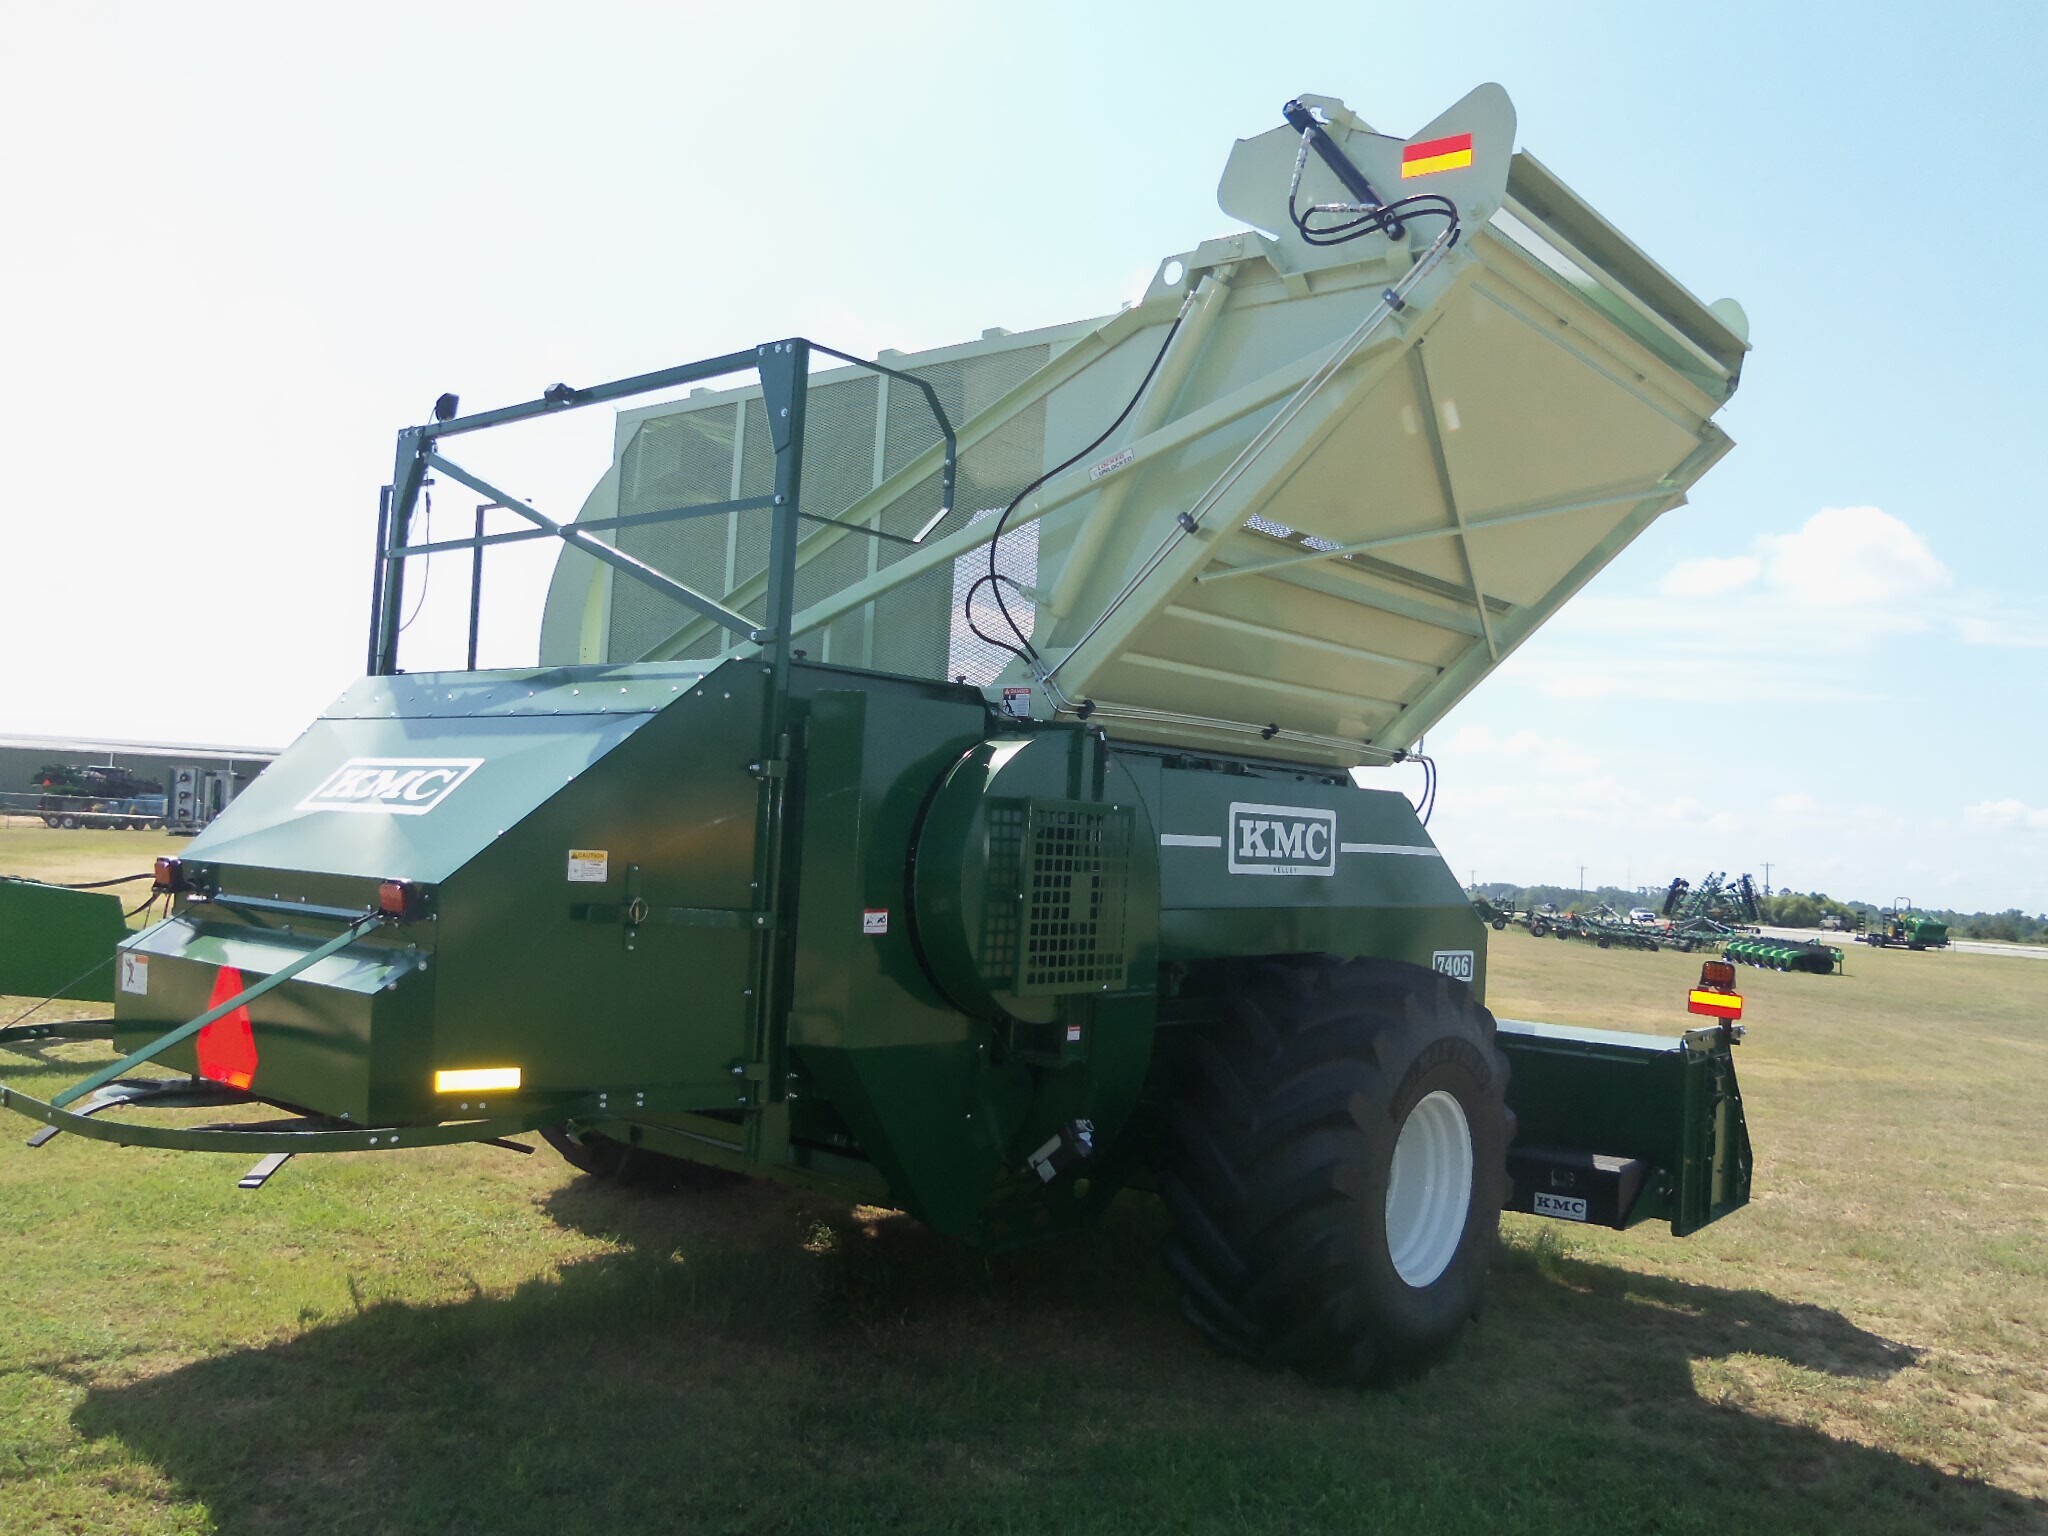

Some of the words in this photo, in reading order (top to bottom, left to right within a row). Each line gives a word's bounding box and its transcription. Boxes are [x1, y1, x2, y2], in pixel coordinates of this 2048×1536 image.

[1098, 456, 1133, 477] UNLOCKED
[319, 769, 459, 801] KMC
[1239, 819, 1328, 861] KMC
[577, 852, 605, 860] CAUTION
[1273, 866, 1298, 874] KELLEY
[1437, 955, 1469, 977] 7406
[1536, 1196, 1585, 1214] KMC
